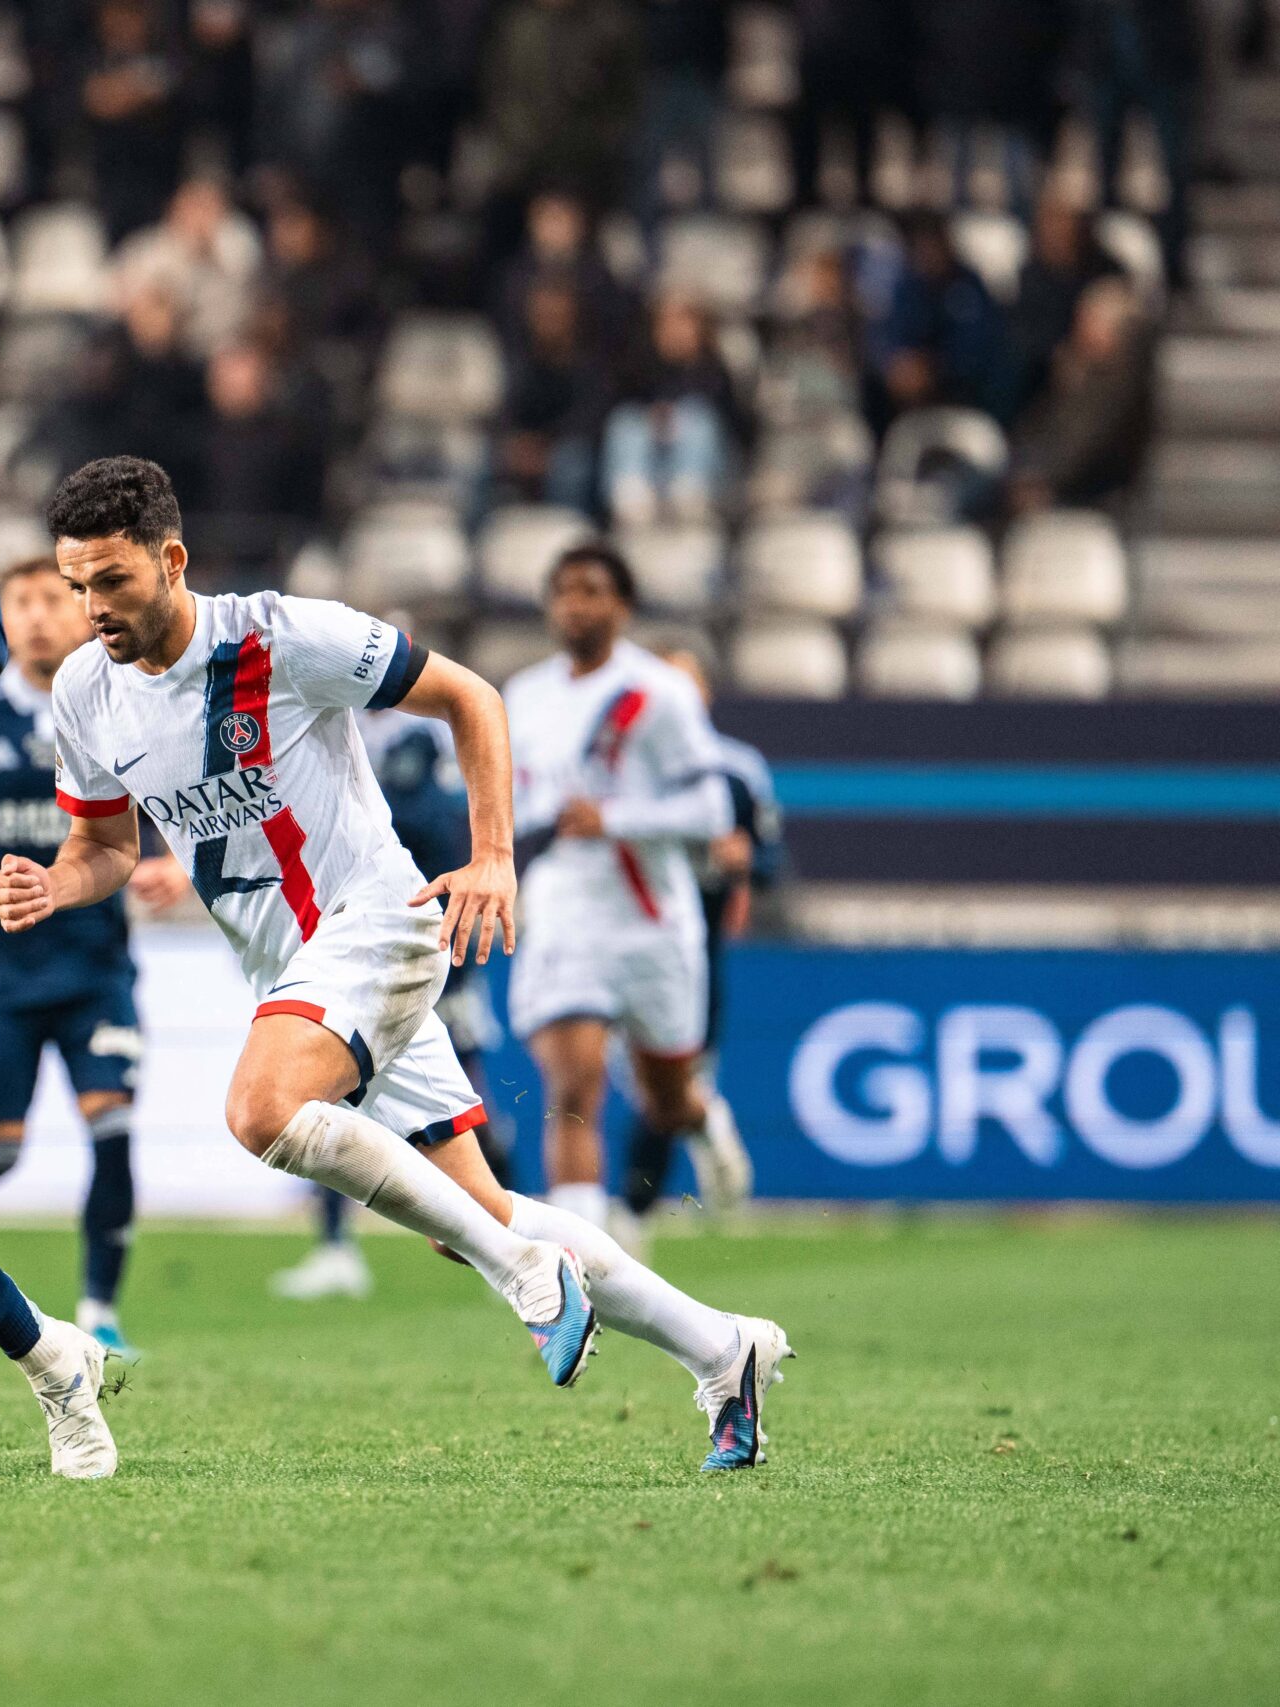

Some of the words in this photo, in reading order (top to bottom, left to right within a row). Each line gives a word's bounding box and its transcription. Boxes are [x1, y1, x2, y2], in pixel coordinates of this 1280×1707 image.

[223, 714, 249, 728] PARIS
[143, 766, 273, 827] QATAR
[189, 792, 282, 839] AIRWAYS
